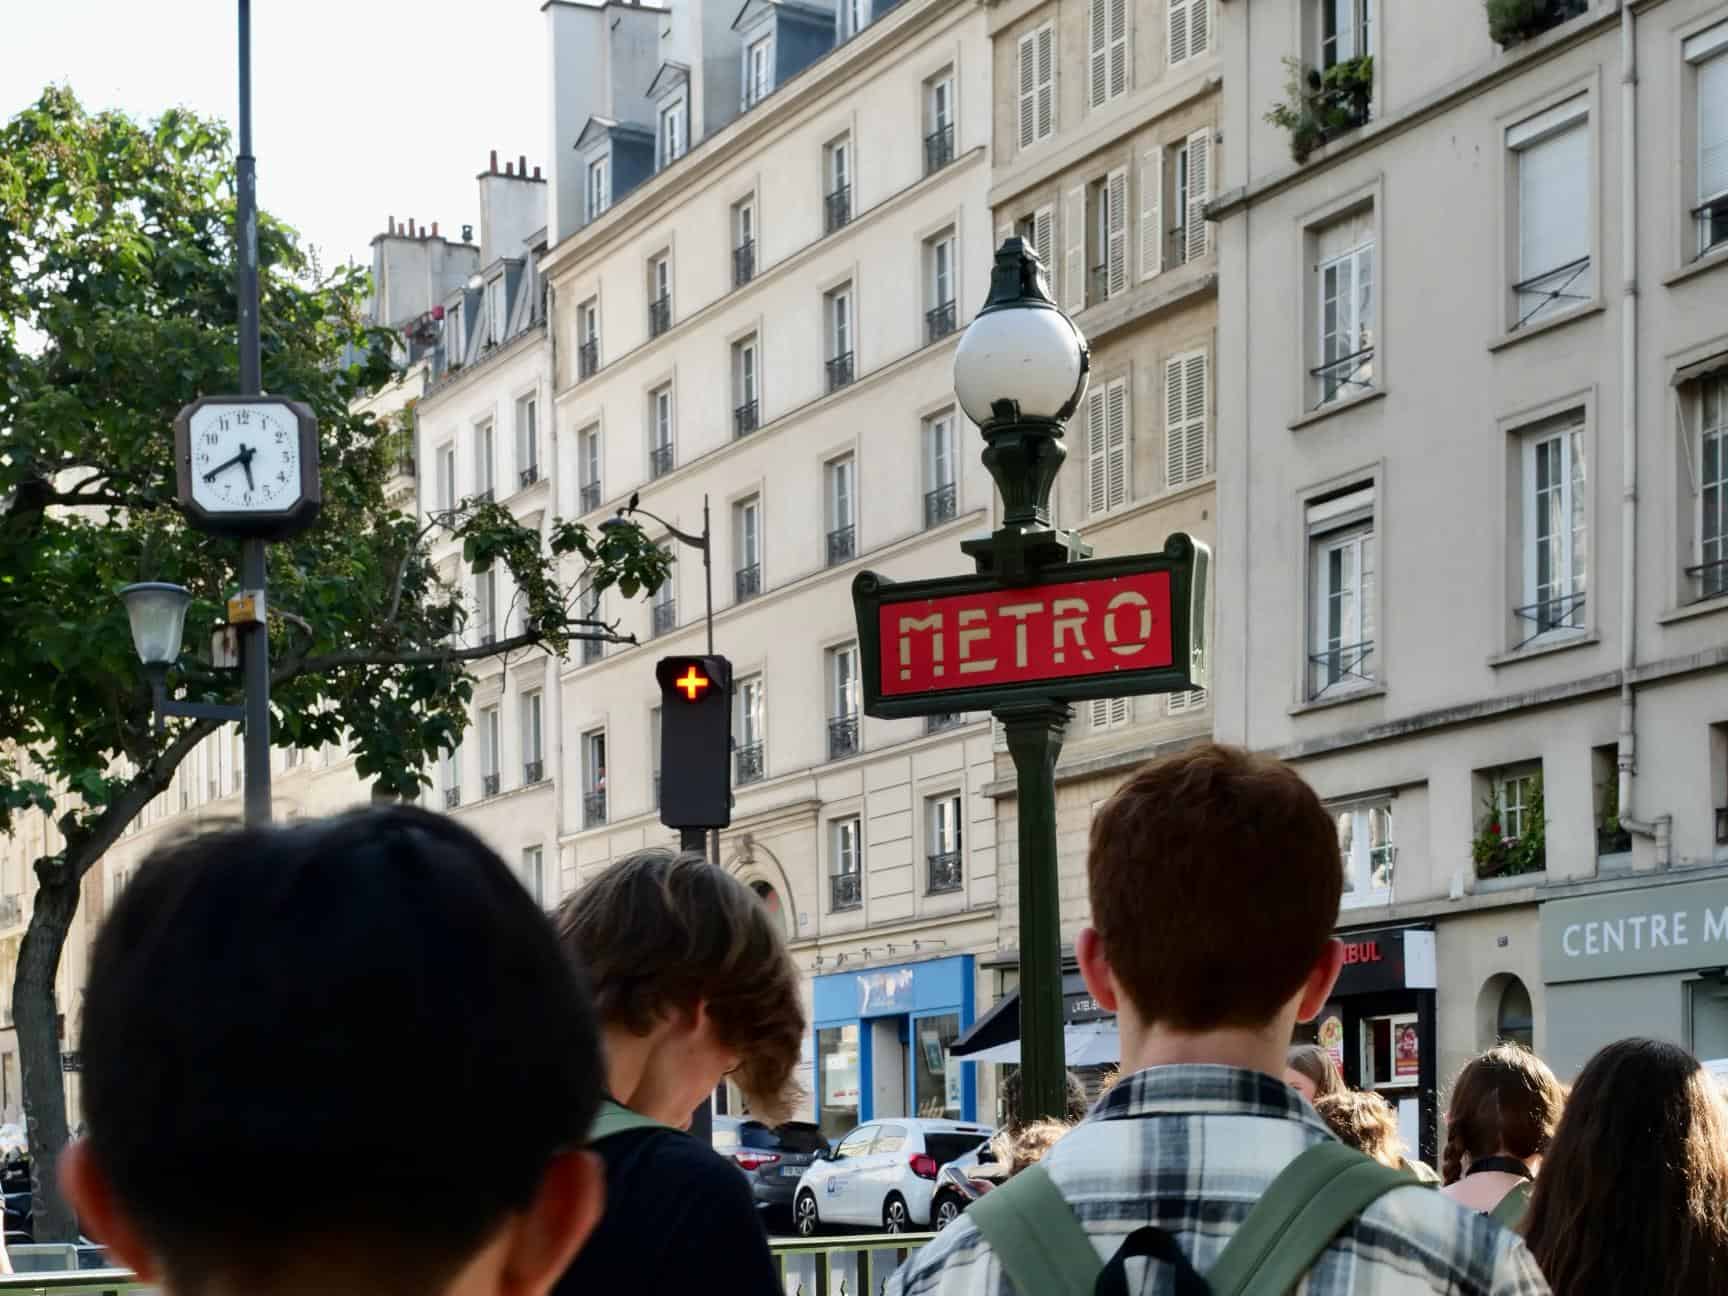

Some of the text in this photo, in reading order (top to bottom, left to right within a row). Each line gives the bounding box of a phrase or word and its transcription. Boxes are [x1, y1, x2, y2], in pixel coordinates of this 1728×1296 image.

[219, 416, 230, 431] 11
[236, 410, 249, 425] 12
[205, 433, 219, 445] 10
[275, 432, 283, 443] 2
[276, 470, 286, 482] 4
[900, 591, 1151, 681] METRO
[1562, 911, 1688, 957] CENTRE
